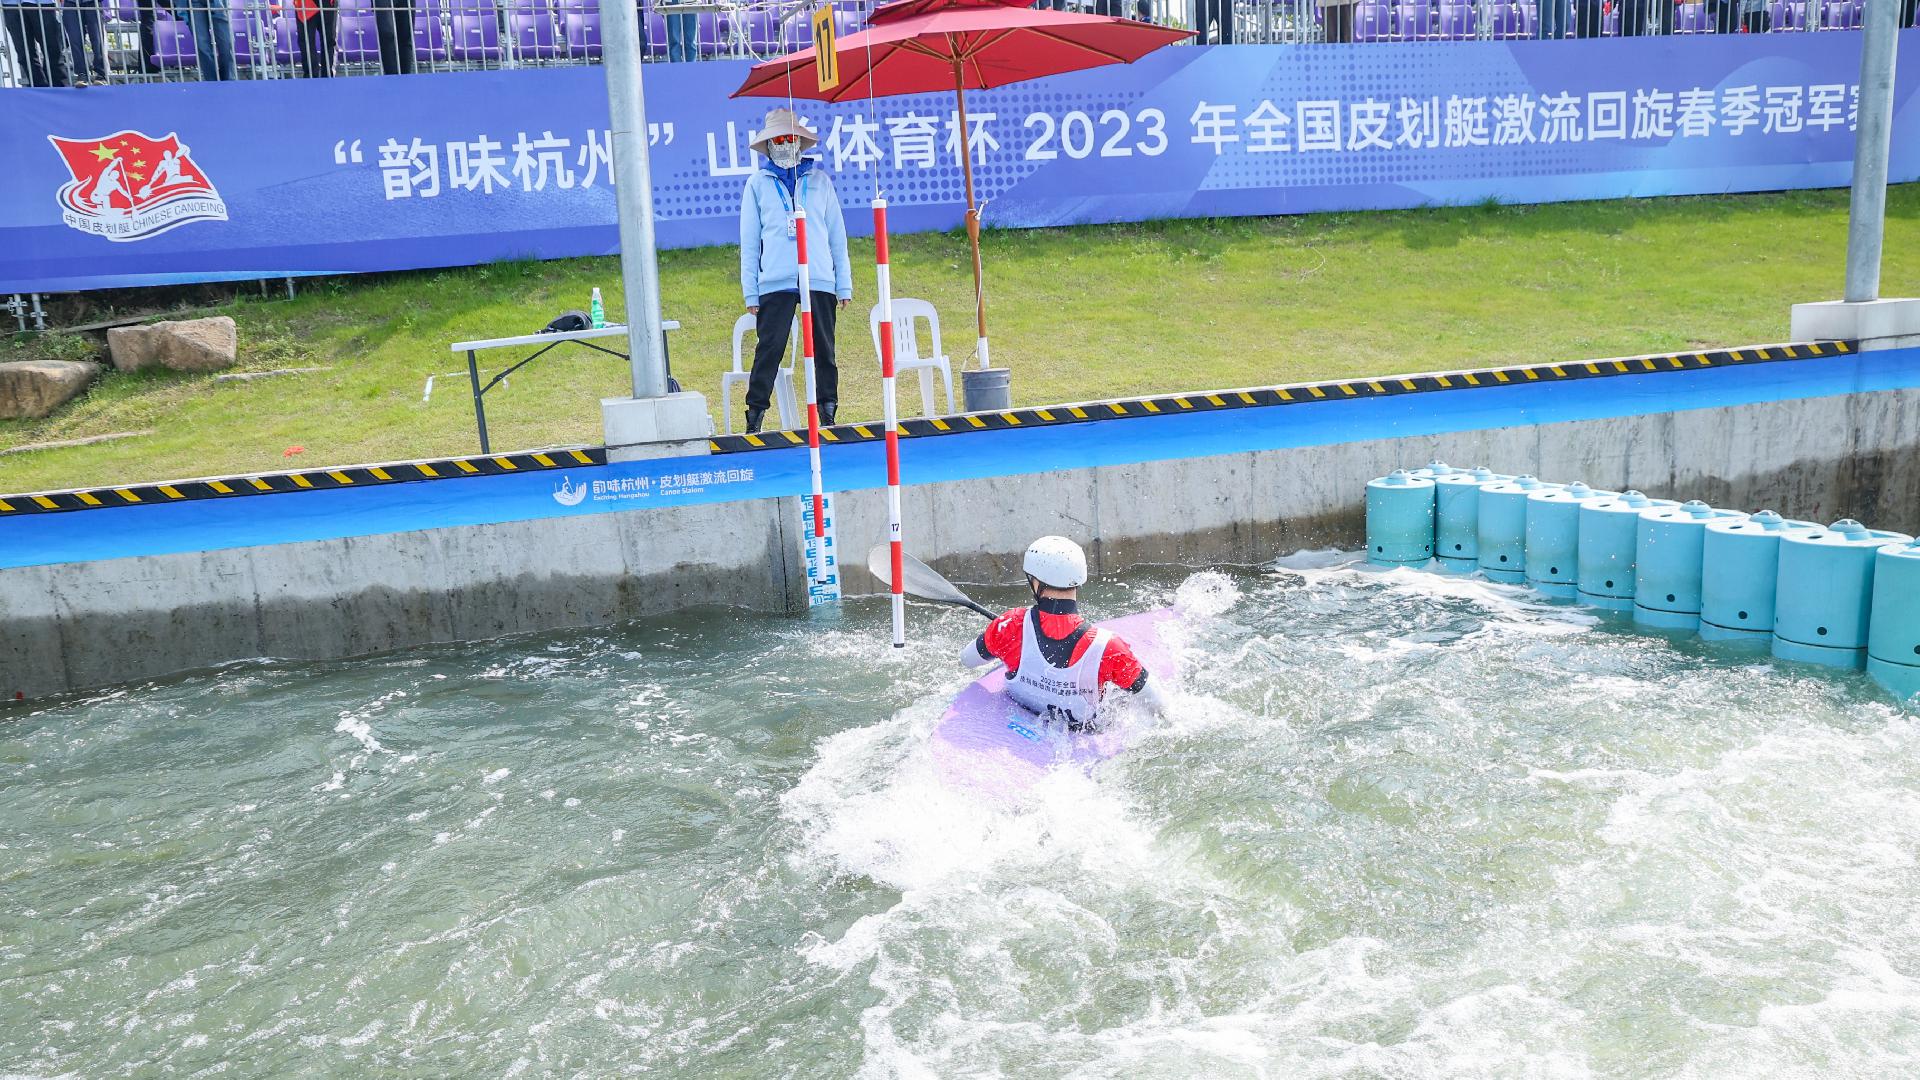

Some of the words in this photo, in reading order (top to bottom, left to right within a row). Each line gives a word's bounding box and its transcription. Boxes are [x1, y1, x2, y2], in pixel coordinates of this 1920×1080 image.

[815, 17, 832, 82] 17
[1023, 107, 1169, 160] 2023
[1188, 84, 1860, 155] 年全国皮划艇激流回旋春季冠军
[65, 212, 131, 234] 中国皮划艇
[132, 209, 172, 231] CHINESE
[174, 201, 224, 217] CANOEING
[660, 488, 680, 496] Canoe
[891, 523, 900, 532] 17
